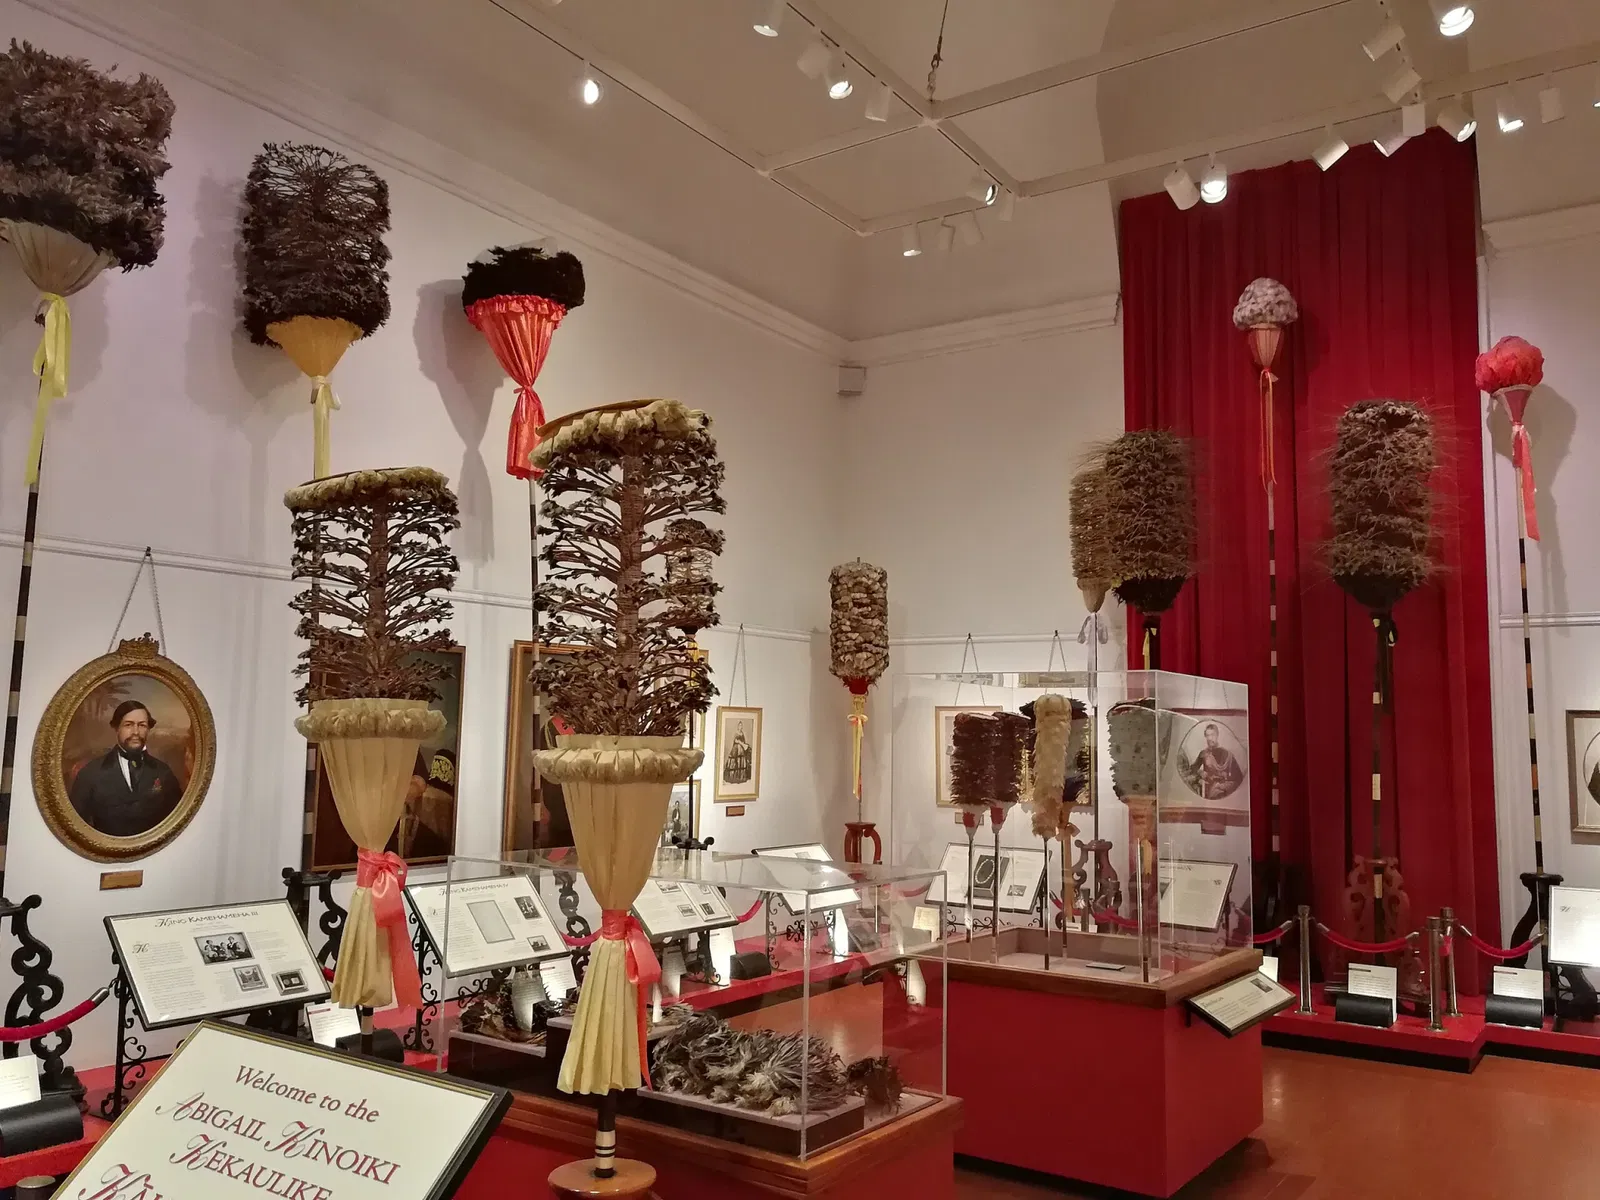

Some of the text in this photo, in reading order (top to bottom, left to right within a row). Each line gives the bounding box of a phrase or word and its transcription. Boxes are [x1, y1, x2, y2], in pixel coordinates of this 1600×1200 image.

[155, 917, 187, 928] KING
[188, 911, 249, 923] KAMEHAMEHA
[235, 1065, 380, 1123] Welcome to the
[154, 1091, 401, 1185] ABIGAIL KINOIKI
[168, 1133, 333, 1200] KEKAULIKE
